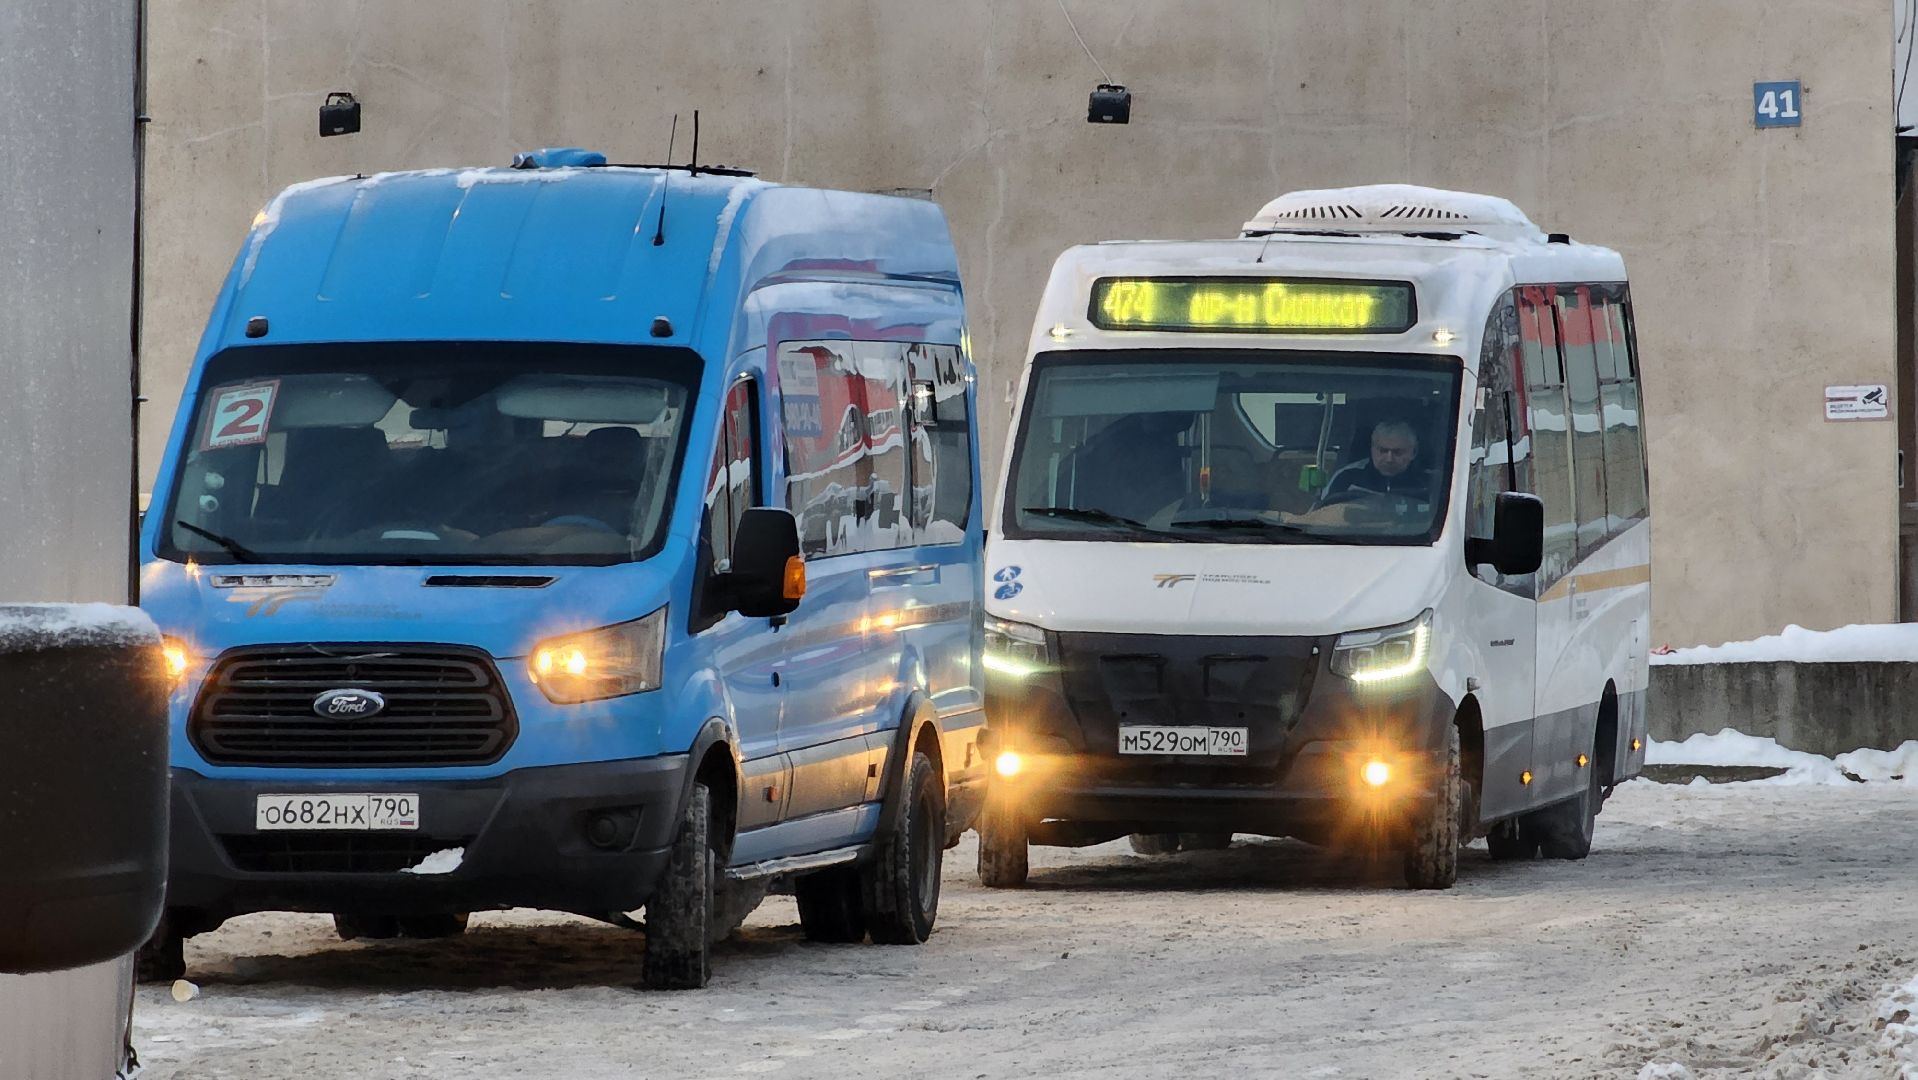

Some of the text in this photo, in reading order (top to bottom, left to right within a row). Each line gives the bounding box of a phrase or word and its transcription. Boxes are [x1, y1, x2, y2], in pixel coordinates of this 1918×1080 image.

[1758, 89, 1799, 118] 41
[1103, 281, 1154, 322] 474
[216, 398, 264, 438] 2
[328, 695, 368, 714] Ford
[1210, 730, 1241, 747] 790
[371, 798, 410, 818] 790
[380, 818, 399, 826] RUS
